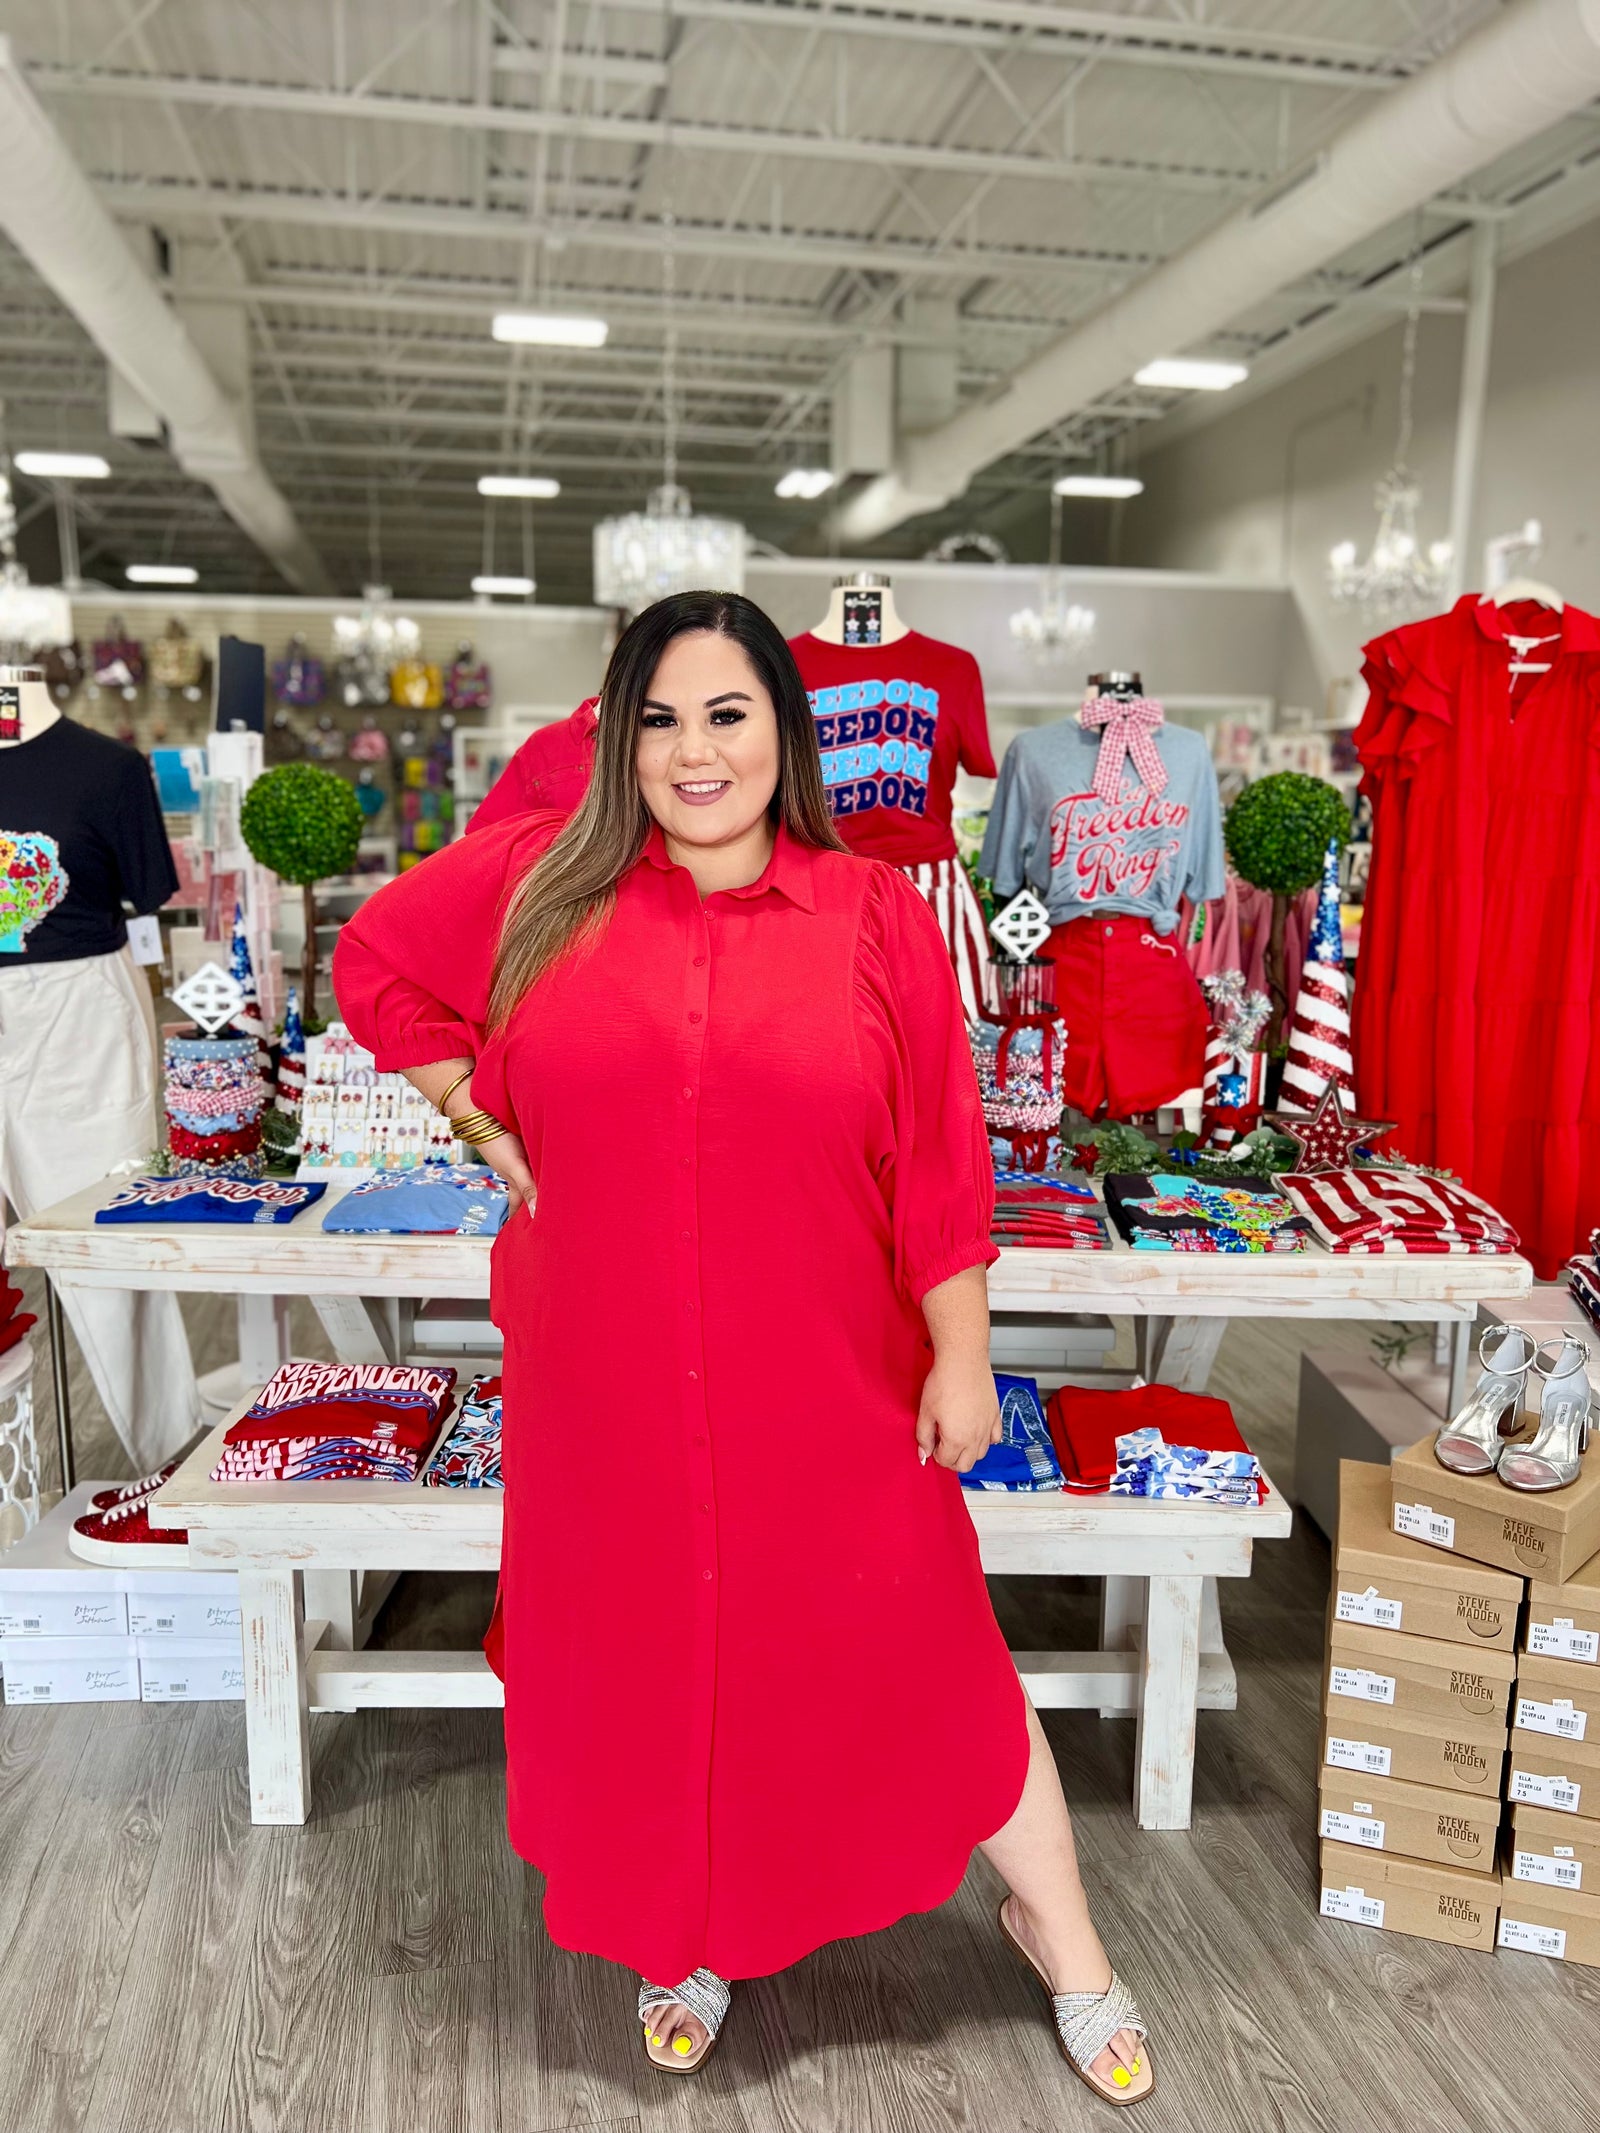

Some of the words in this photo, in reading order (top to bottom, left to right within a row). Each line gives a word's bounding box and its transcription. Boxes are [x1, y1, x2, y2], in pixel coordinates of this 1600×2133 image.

[806, 679, 939, 717] EEDOM
[815, 706, 937, 749] EEDOM
[1050, 790, 1189, 868] Freedom
[1076, 836, 1180, 901] Ring
[257, 1365, 448, 1410] NDEPENDENC
[1503, 1518, 1535, 1539] STEVE
[1502, 1531, 1545, 1553] MADDEN
[1457, 1595, 1490, 1611] STEVE
[1456, 1606, 1500, 1624] MADDEN
[1450, 1671, 1483, 1688] STEVE
[1449, 1681, 1494, 1701] MADDEN
[1522, 1703, 1535, 1711] ELLA
[1444, 1740, 1477, 1757] STEVE
[1443, 1751, 1487, 1770] MADDEN
[1438, 1815, 1470, 1832] STEVE
[1437, 1825, 1480, 1844] MADDEN
[1438, 1895, 1471, 1911] STEVE
[1437, 1905, 1481, 1924] MADDEN
